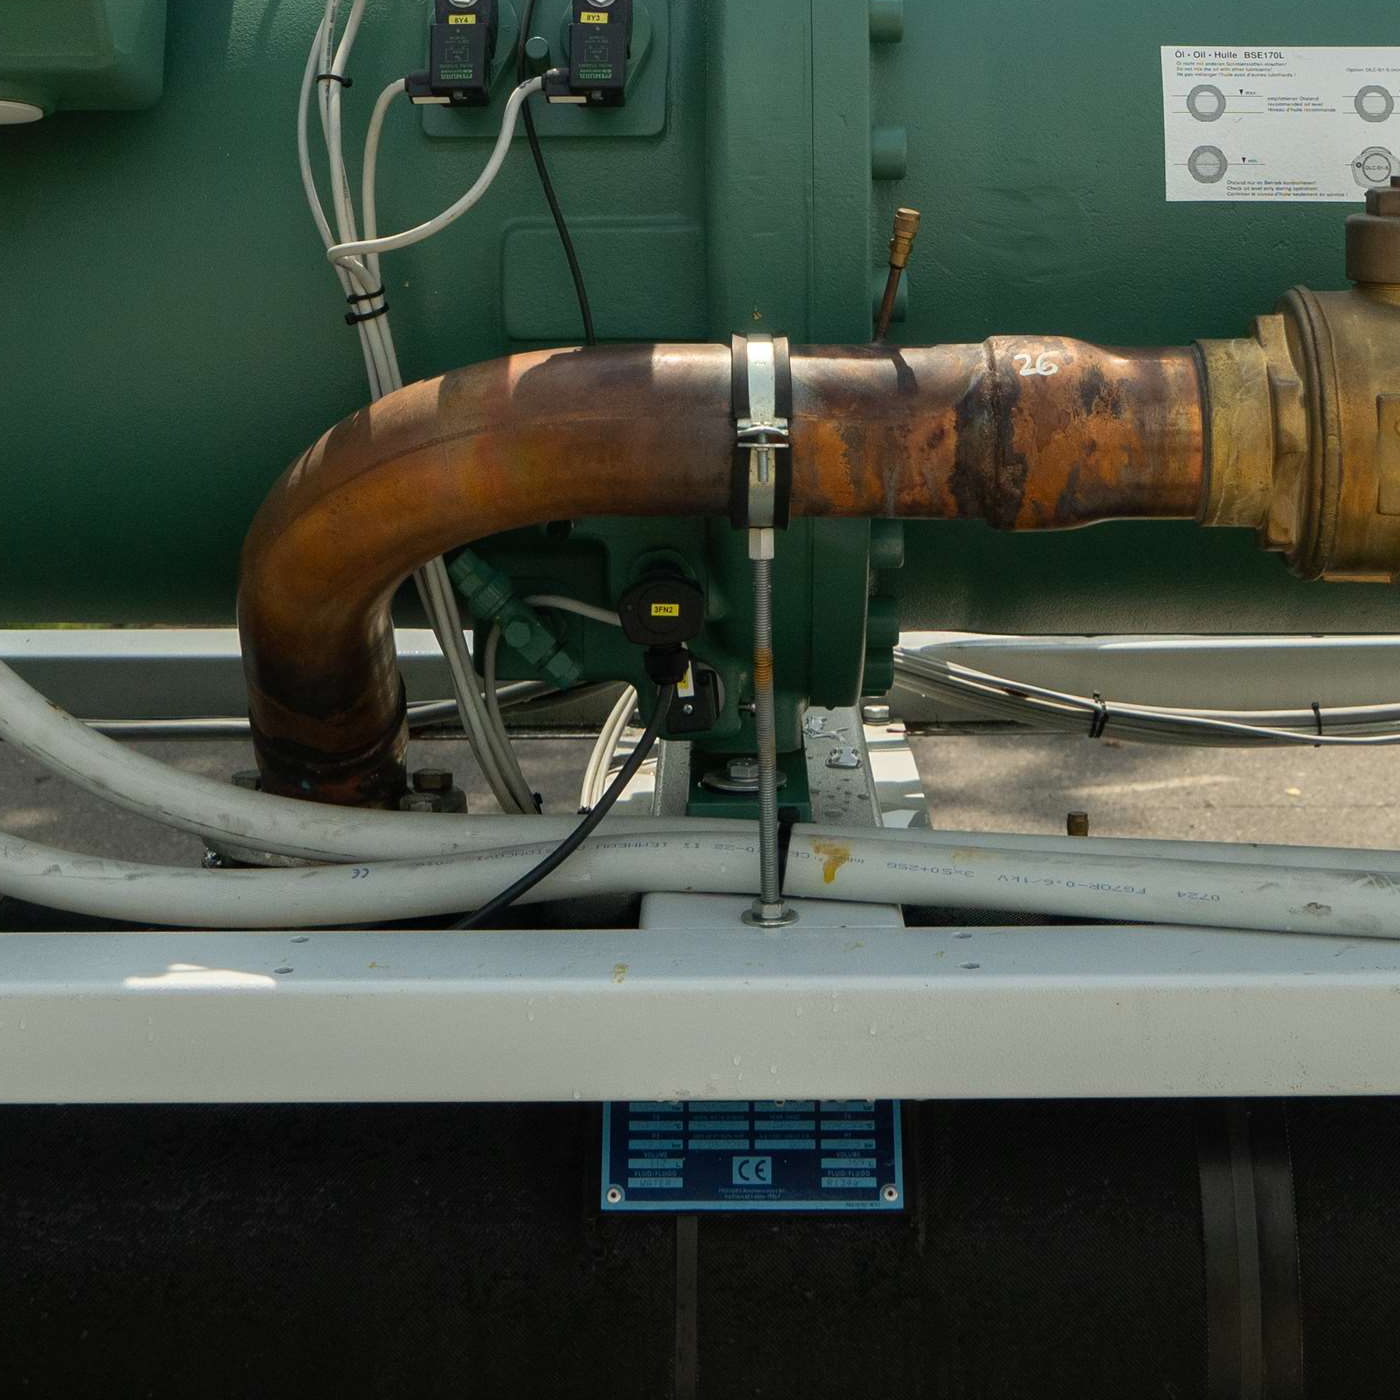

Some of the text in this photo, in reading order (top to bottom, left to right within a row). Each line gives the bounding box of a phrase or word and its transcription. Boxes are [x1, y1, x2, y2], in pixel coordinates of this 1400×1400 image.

[1193, 50, 1206, 59] Oil
[1214, 50, 1238, 59] Huile
[1244, 51, 1285, 60] BSE170L
[1014, 350, 1060, 377] 26
[738, 1159, 766, 1181] CE
